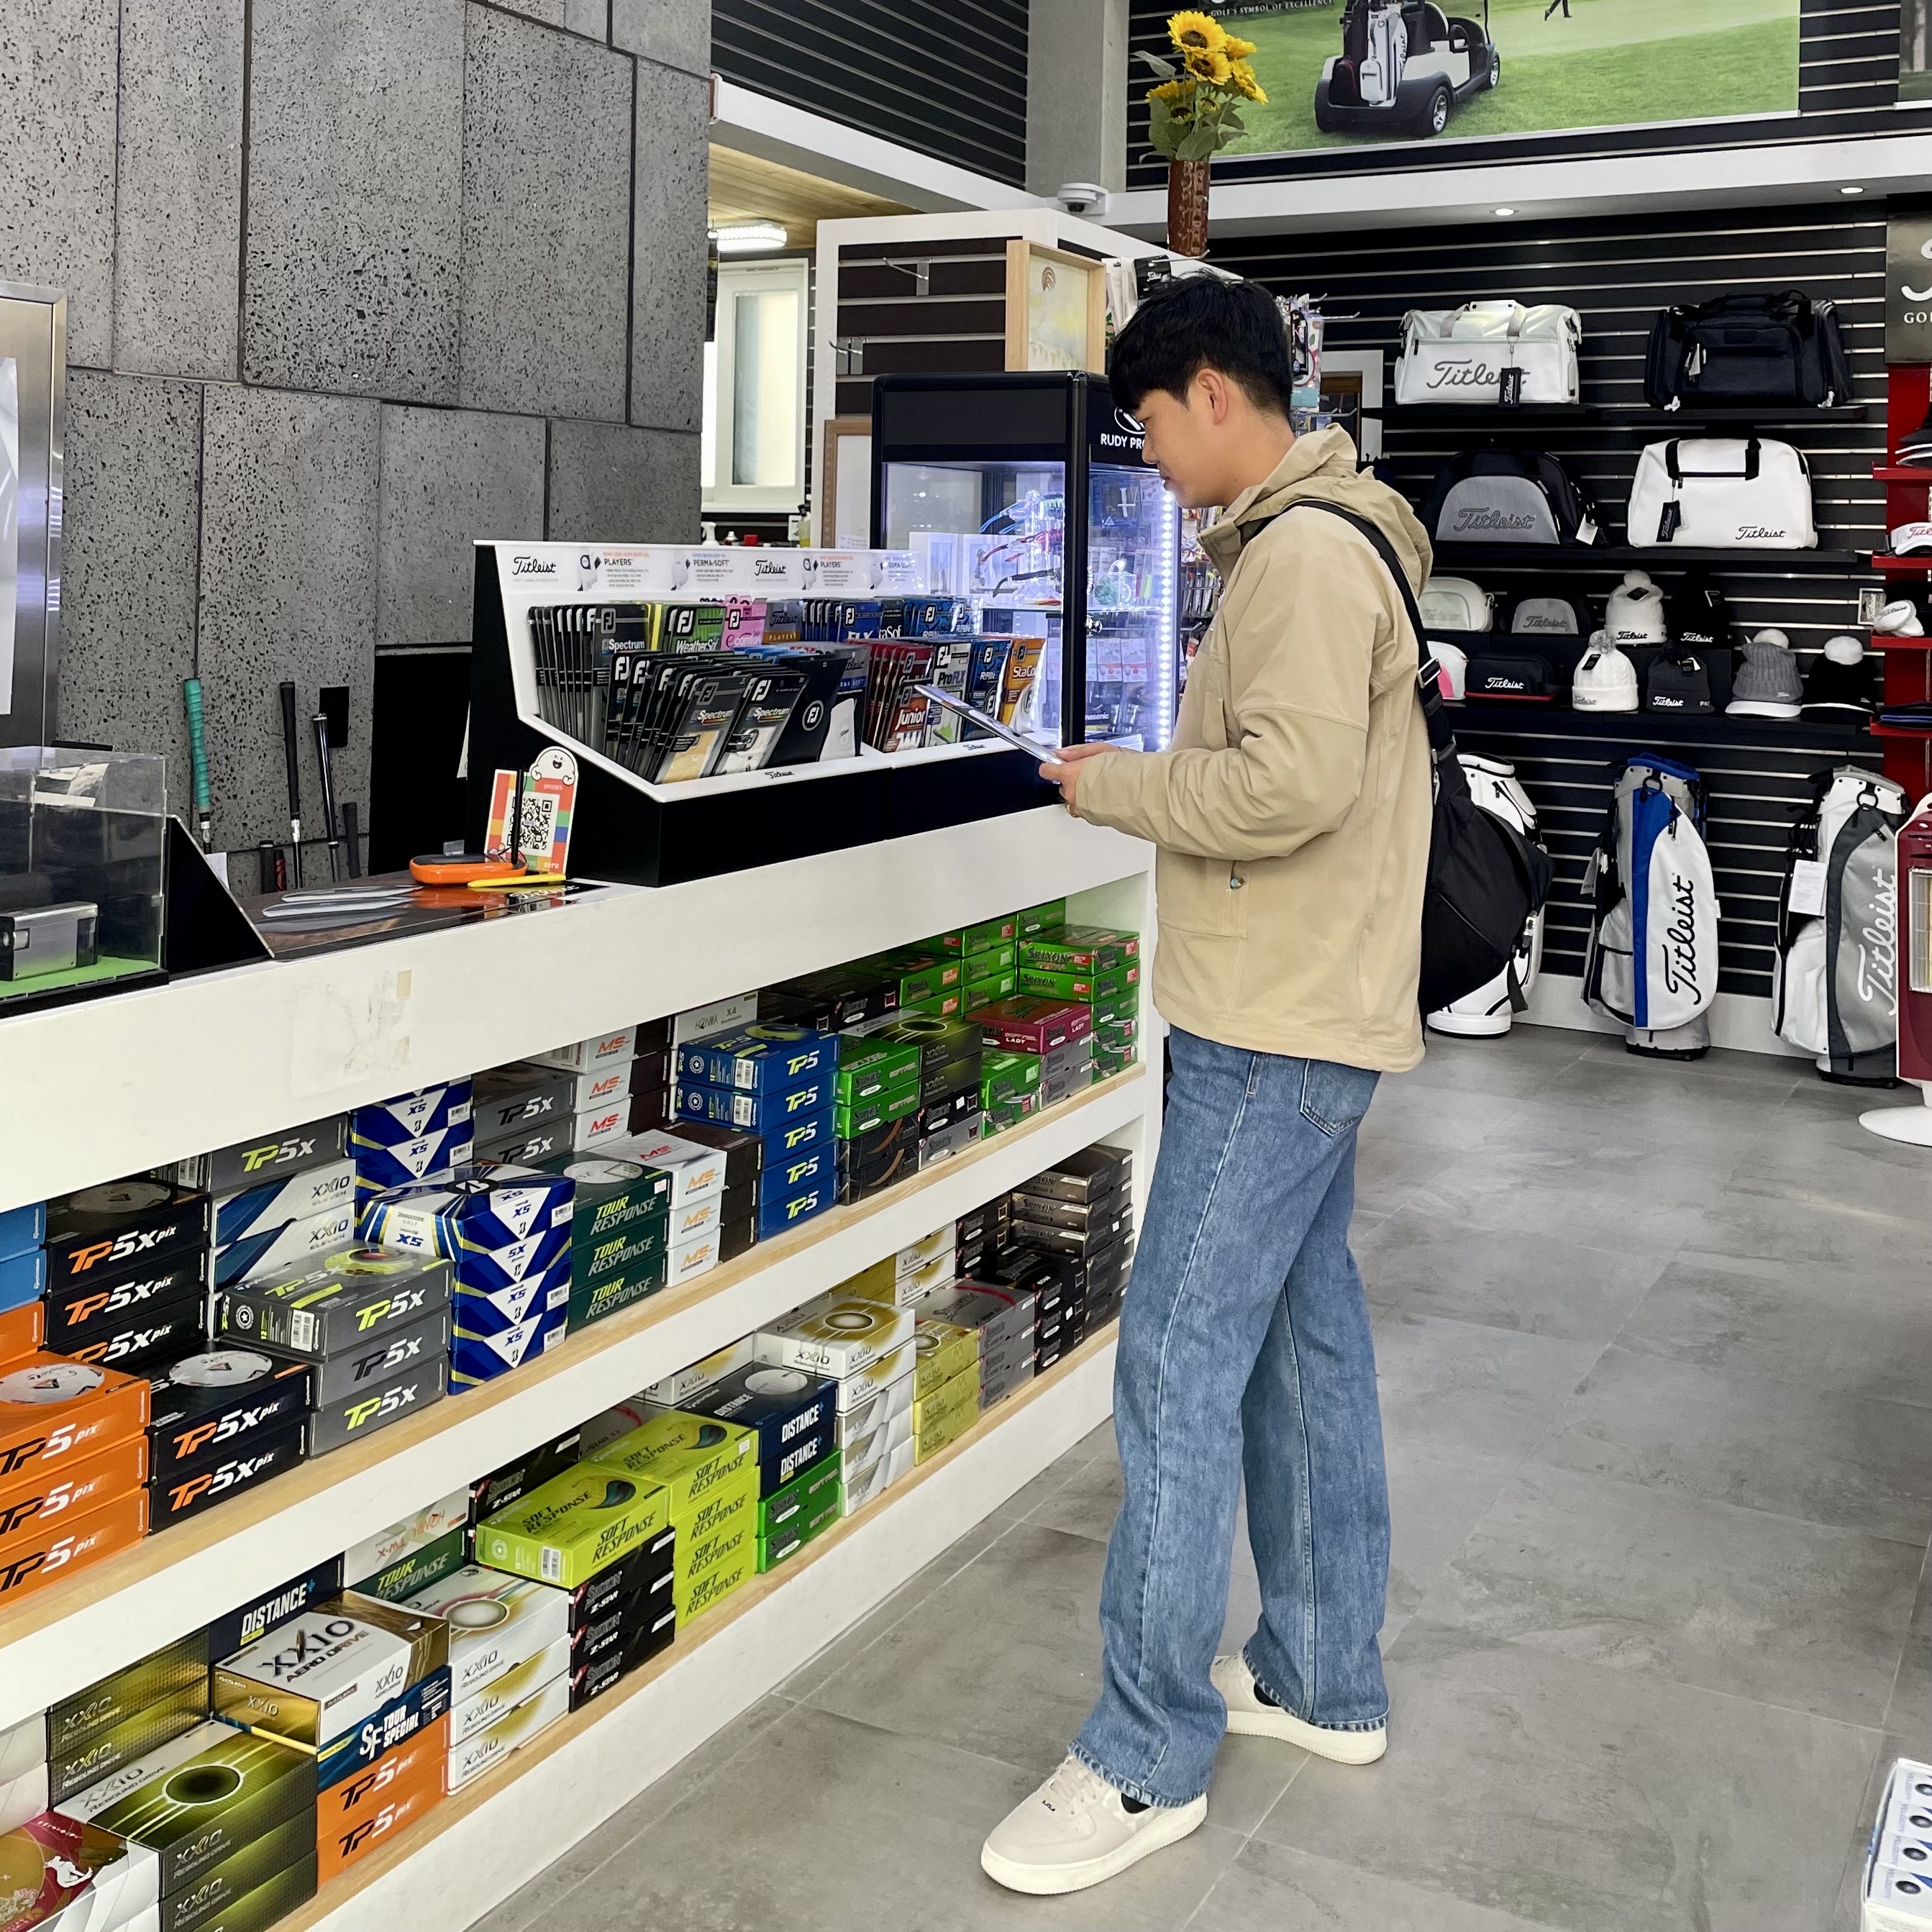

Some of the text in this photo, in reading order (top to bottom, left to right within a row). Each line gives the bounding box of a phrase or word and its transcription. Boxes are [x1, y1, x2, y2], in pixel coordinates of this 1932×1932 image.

[1101, 433, 1128, 447] RUDY
[1453, 507, 1536, 531] Titleist
[1736, 527, 1786, 539] Titleist
[512, 556, 557, 575] Titleist
[755, 560, 786, 575] Titleist
[1523, 616, 1569, 632] Titleist
[1617, 631, 1648, 640] Titleist
[609, 638, 646, 652] Spectrum
[1680, 632, 1714, 643] Titleist
[615, 656, 630, 680] FJ
[751, 680, 772, 701] FJ
[1485, 677, 1524, 690] Titleist
[754, 707, 791, 721] Spectrum
[1653, 696, 1685, 707] Titleist
[698, 709, 734, 722] Spectrum
[806, 706, 819, 724] FJ
[894, 708, 926, 732] Junior
[1662, 875, 1702, 1006] Titleist
[786, 1049, 821, 1077] TP5
[785, 1085, 819, 1113] TP5
[784, 1121, 819, 1149] TP5
[785, 1155, 820, 1185] TP5
[311, 1175, 351, 1200] XXIO
[590, 1196, 657, 1236] RESPONSE
[596, 1195, 630, 1218] TOUR
[785, 1190, 820, 1220] TP5
[155, 1226, 178, 1244] pix
[309, 1218, 350, 1244] XXIO
[588, 1236, 655, 1277] RESPONSE
[593, 1236, 628, 1262] TOUR
[150, 1275, 174, 1294] pix
[591, 1277, 626, 1304] TOUR
[585, 1276, 654, 1321] RESPONSE
[258, 1400, 281, 1421] pix
[74, 1423, 99, 1445] pix
[254, 1452, 276, 1472] pix
[693, 1456, 723, 1482] SOFT
[688, 1453, 746, 1498] RESPONSE
[71, 1482, 97, 1503] pix
[492, 1487, 522, 1509] Z-STAR
[522, 1504, 552, 1528] SOFT
[525, 1490, 592, 1534] RESPONSE
[691, 1493, 747, 1541] RESPONSE
[695, 1498, 724, 1526] SOFT
[592, 1511, 657, 1564] RESPONSE
[597, 1516, 629, 1547] SOFT
[73, 1534, 98, 1557] pix
[687, 1529, 745, 1580] RESPONSE
[692, 1535, 721, 1562] SOFT
[377, 1558, 416, 1592] TOUR
[689, 1573, 719, 1601] SOFT
[590, 1590, 619, 1615] Z-STAR
[685, 1567, 744, 1618] RESPONSE
[256, 1619, 354, 1678] XXIO
[590, 1631, 619, 1655] Z-STAR
[287, 1630, 369, 1682] AERO DRIVE
[462, 1650, 498, 1682] XXIO
[375, 1663, 404, 1692] XXIO
[590, 1672, 619, 1696] Z-STAR
[247, 1695, 279, 1715] XXIO
[383, 1705, 407, 1727] TOUR
[463, 1695, 499, 1726] XXIO
[360, 1723, 383, 1761] SF
[383, 1711, 419, 1748] SPECIAL
[396, 1755, 414, 1775] pix
[463, 1738, 498, 1769] XXIO
[89, 1764, 168, 1813] REBOUND DRIVE
[394, 1800, 412, 1821] pix
